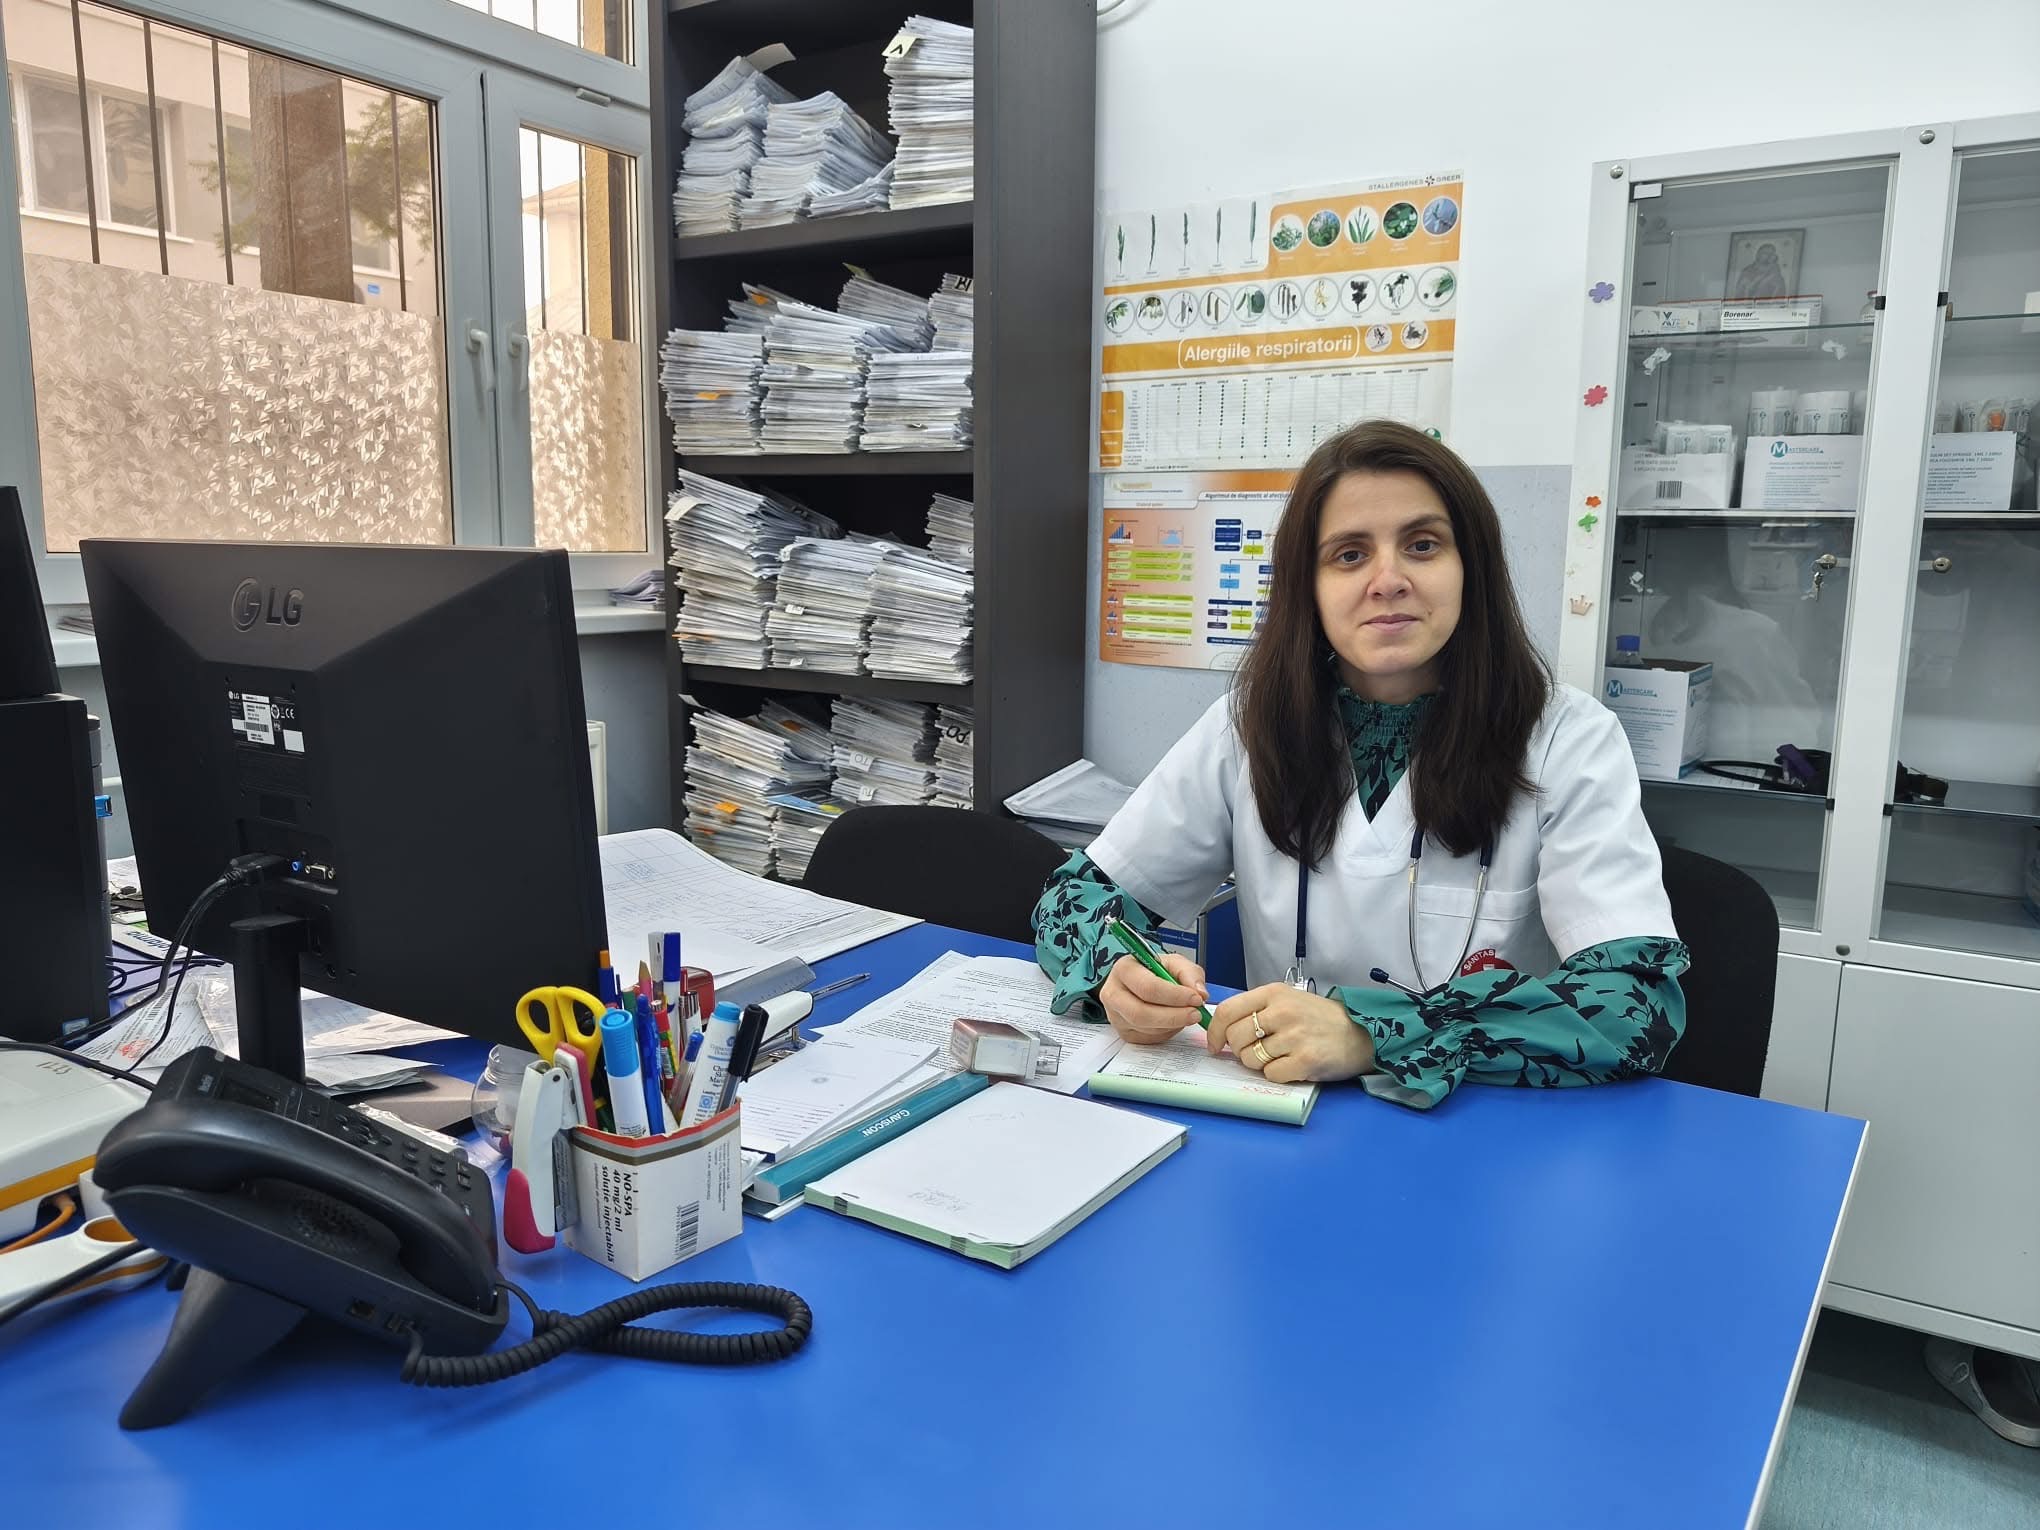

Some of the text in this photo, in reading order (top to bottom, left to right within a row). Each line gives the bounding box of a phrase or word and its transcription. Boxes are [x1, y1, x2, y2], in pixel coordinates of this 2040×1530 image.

[1184, 335, 1353, 363] Alergiile respiratorii
[266, 588, 304, 627] LG
[1463, 949, 1495, 972] SANITAS
[861, 1109, 910, 1138] GAVISCON
[612, 1169, 623, 1233] 40 mg/2 ml
[623, 1172, 633, 1217] NO-SPA
